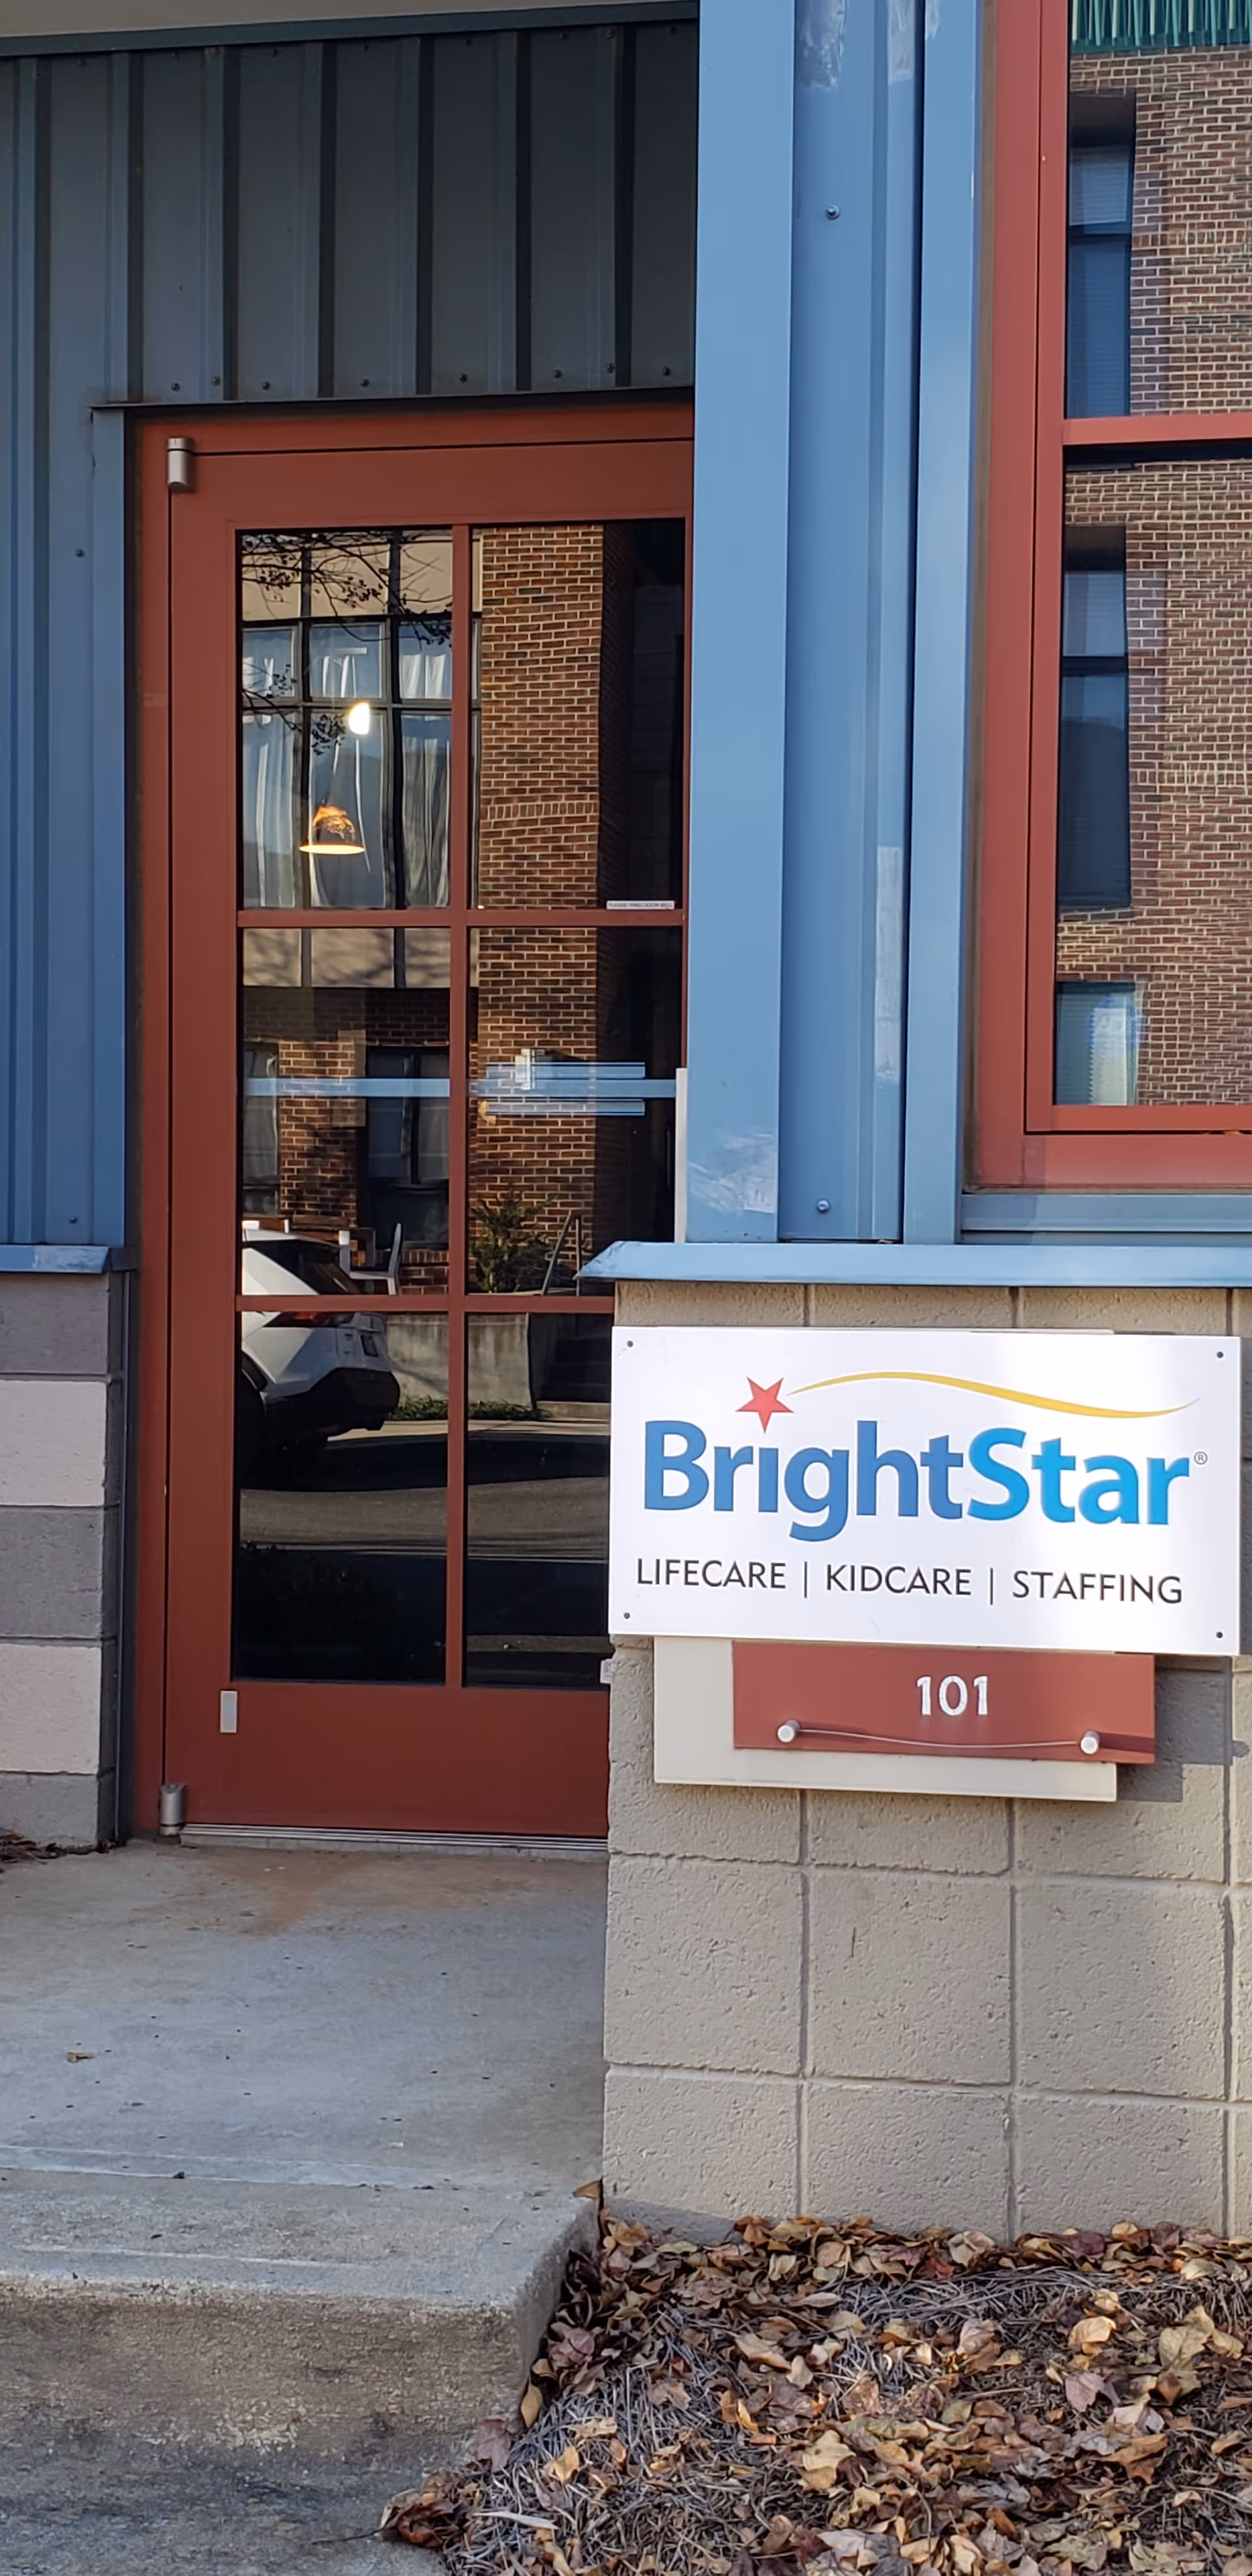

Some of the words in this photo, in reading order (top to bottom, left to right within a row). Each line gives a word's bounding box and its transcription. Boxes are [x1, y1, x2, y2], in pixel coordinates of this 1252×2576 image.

[636, 1557, 786, 1589] LIFECARE
[826, 1563, 972, 1596] KIDCARE
[1012, 1570, 1182, 1605] STAFFING
[916, 1675, 989, 1716] 101
